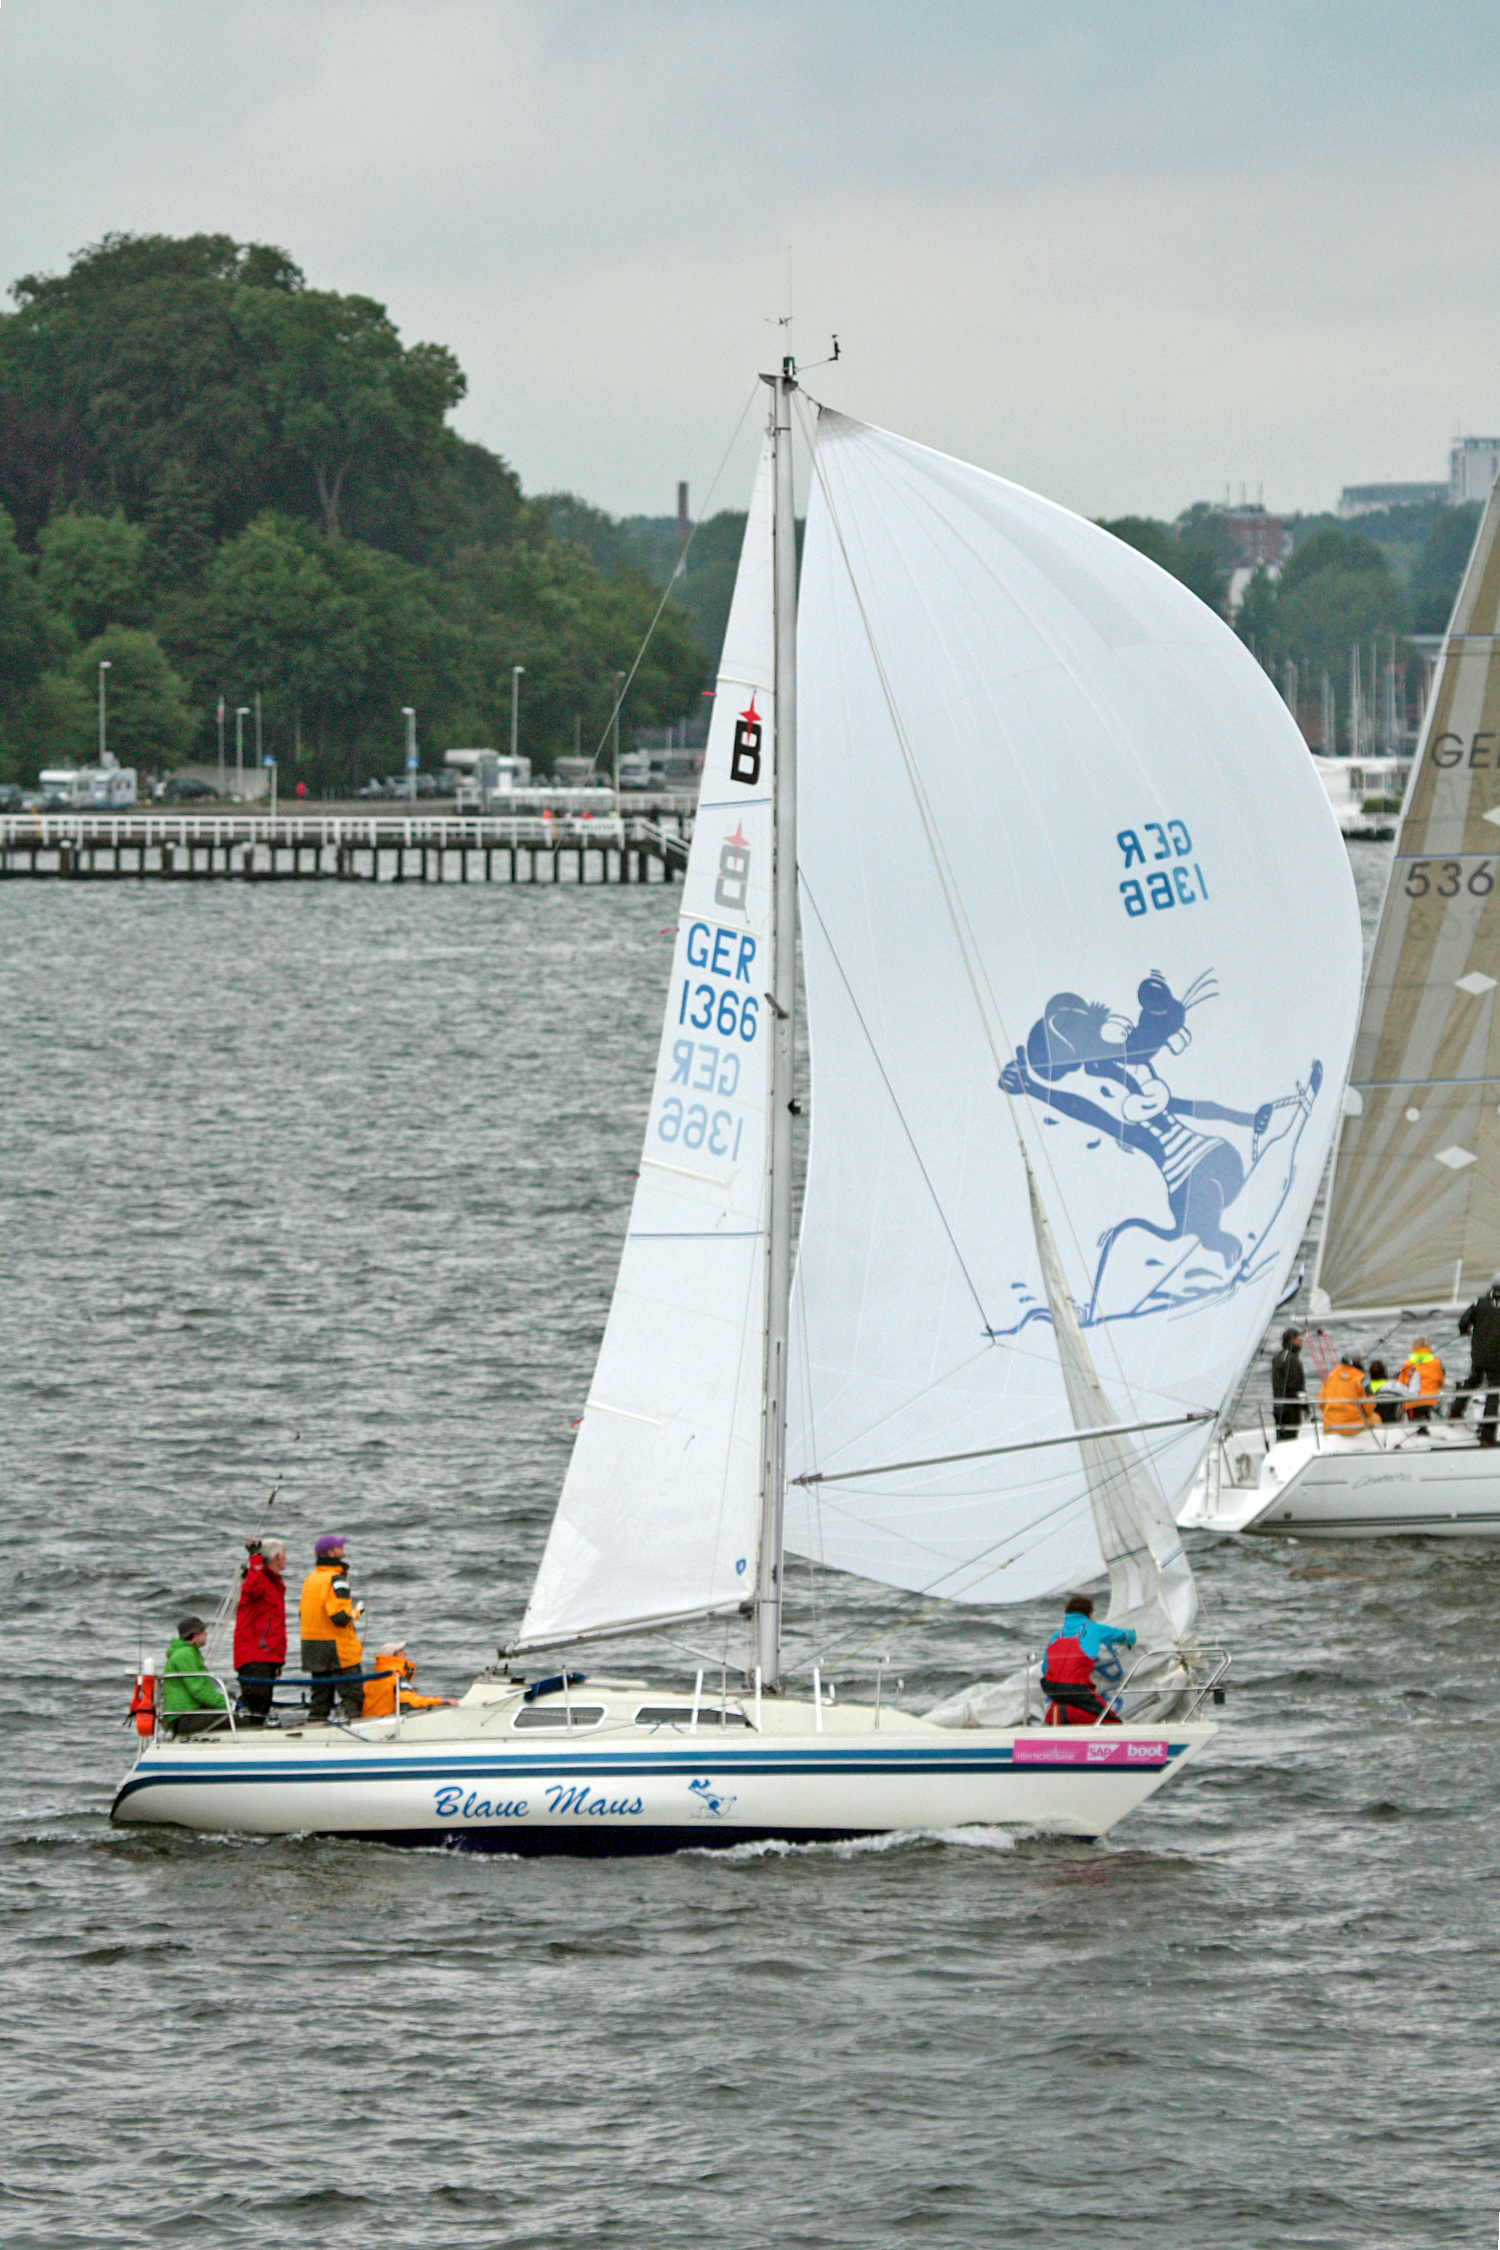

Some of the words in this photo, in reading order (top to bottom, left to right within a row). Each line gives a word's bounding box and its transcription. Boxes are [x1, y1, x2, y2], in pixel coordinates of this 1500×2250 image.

[1431, 732, 1500, 768] GE
[1405, 860, 1495, 898] 536
[687, 922, 757, 984] GER
[679, 979, 760, 1042] 1366
[1087, 1745, 1114, 1759] SAP
[1127, 1744, 1164, 1757] boot
[433, 1785, 531, 1819] Blaue
[545, 1784, 645, 1816] Maus
